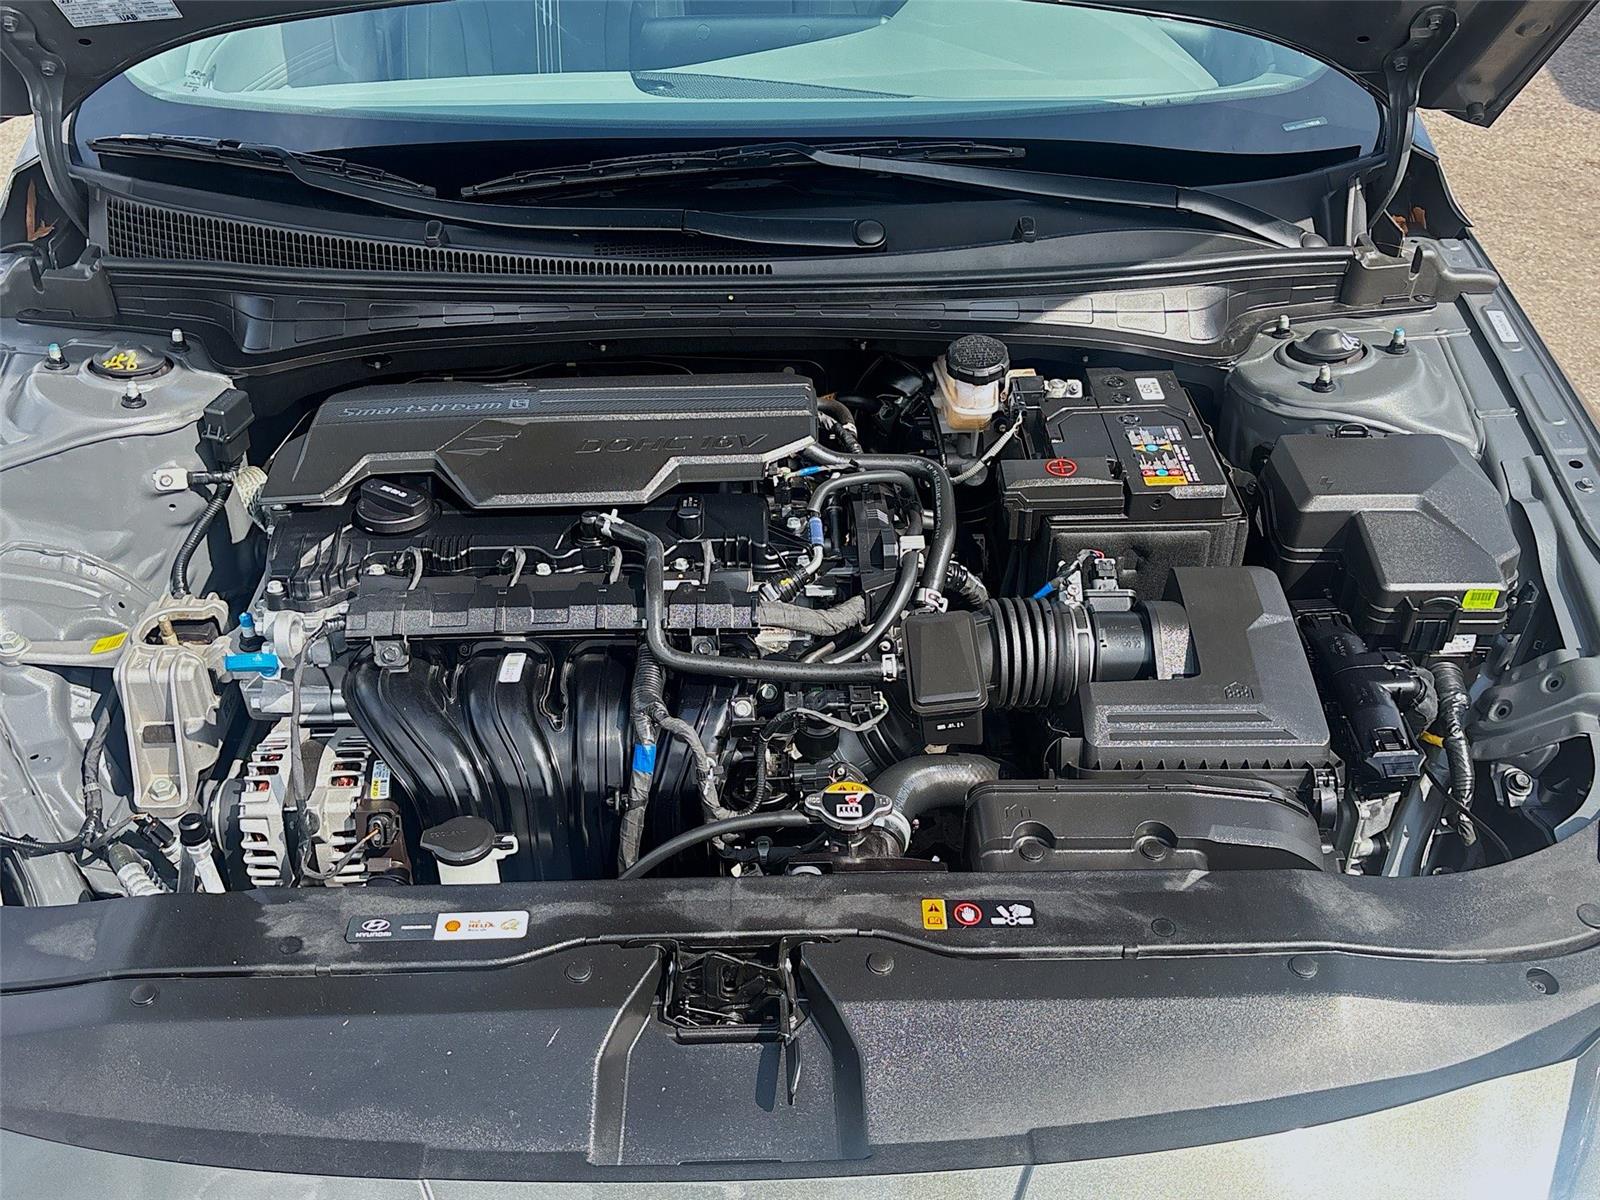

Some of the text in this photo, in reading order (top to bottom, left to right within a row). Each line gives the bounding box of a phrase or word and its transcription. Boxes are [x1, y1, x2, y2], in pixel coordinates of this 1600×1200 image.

[338, 403, 502, 417] Smartstream
[576, 433, 769, 454] DOHC 16V
